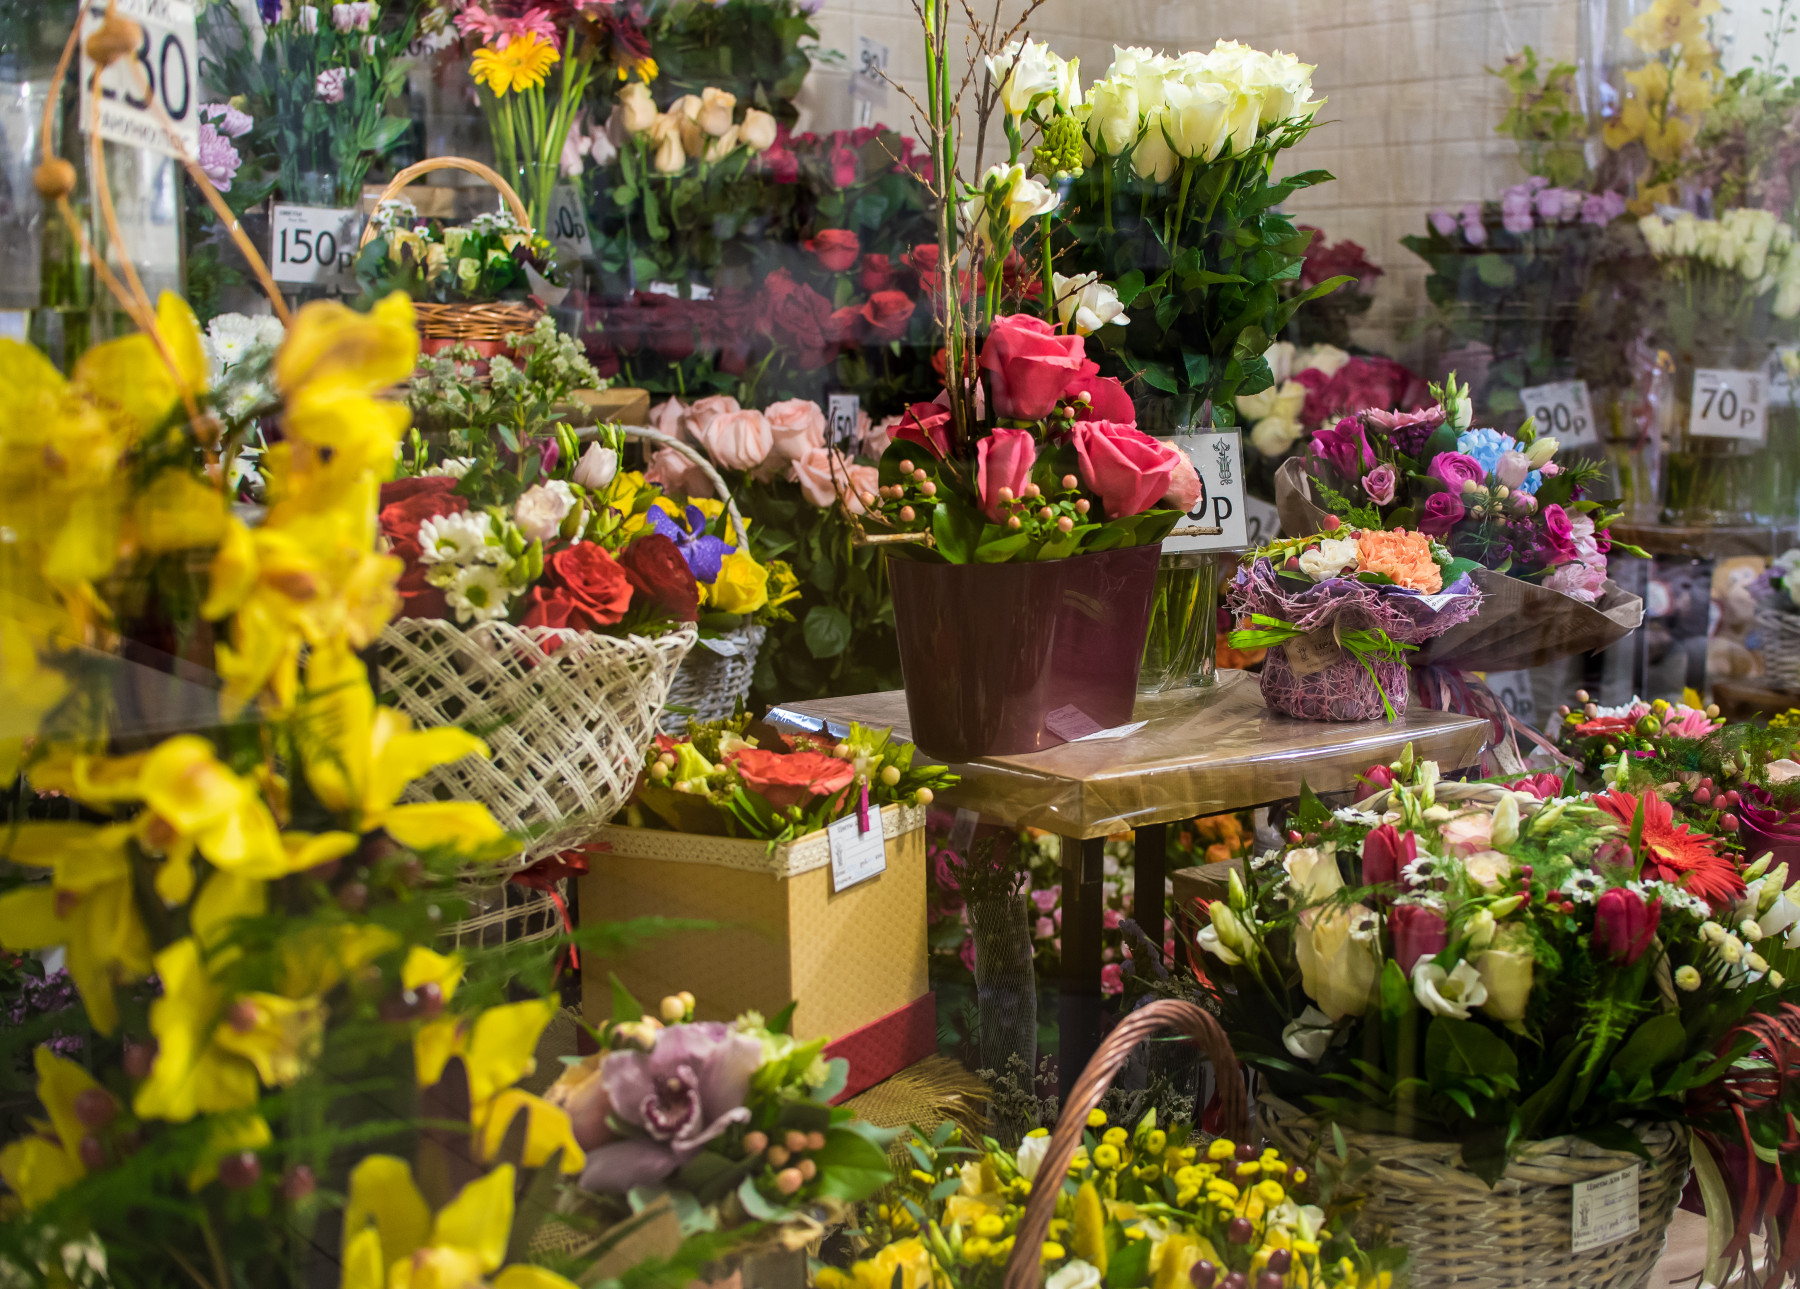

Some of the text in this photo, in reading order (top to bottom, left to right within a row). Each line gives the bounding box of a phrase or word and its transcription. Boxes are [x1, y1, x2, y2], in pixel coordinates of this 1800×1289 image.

[281, 228, 351, 274] 150р
[1535, 403, 1586, 436] 90р
[1702, 388, 1755, 428] 70р
